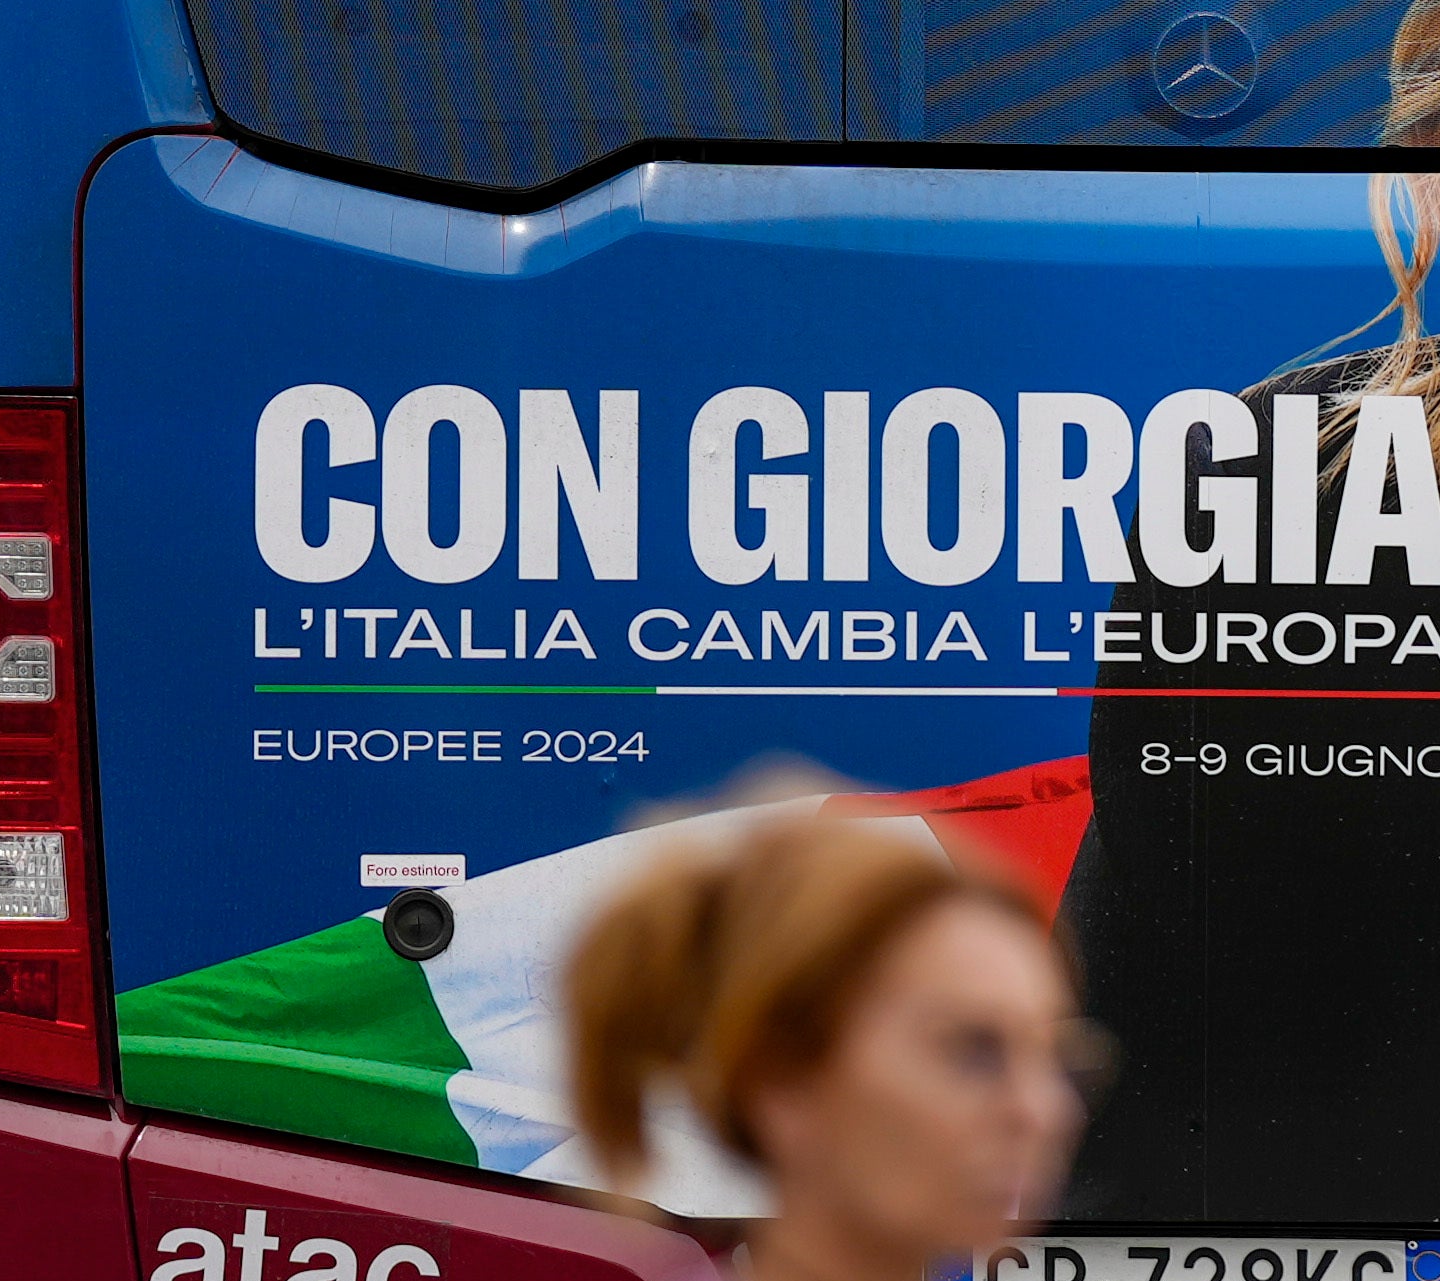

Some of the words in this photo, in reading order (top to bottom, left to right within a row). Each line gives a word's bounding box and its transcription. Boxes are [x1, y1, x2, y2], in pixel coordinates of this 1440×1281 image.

[255, 383, 639, 584] CON
[254, 608, 597, 660] L'ITALIA
[627, 609, 988, 662] CAMBIA
[252, 730, 502, 762] EUROPEE
[522, 731, 649, 762] 2024
[1140, 743, 1227, 775] 8-9
[367, 864, 397, 876] Foro
[402, 864, 459, 876] estintore
